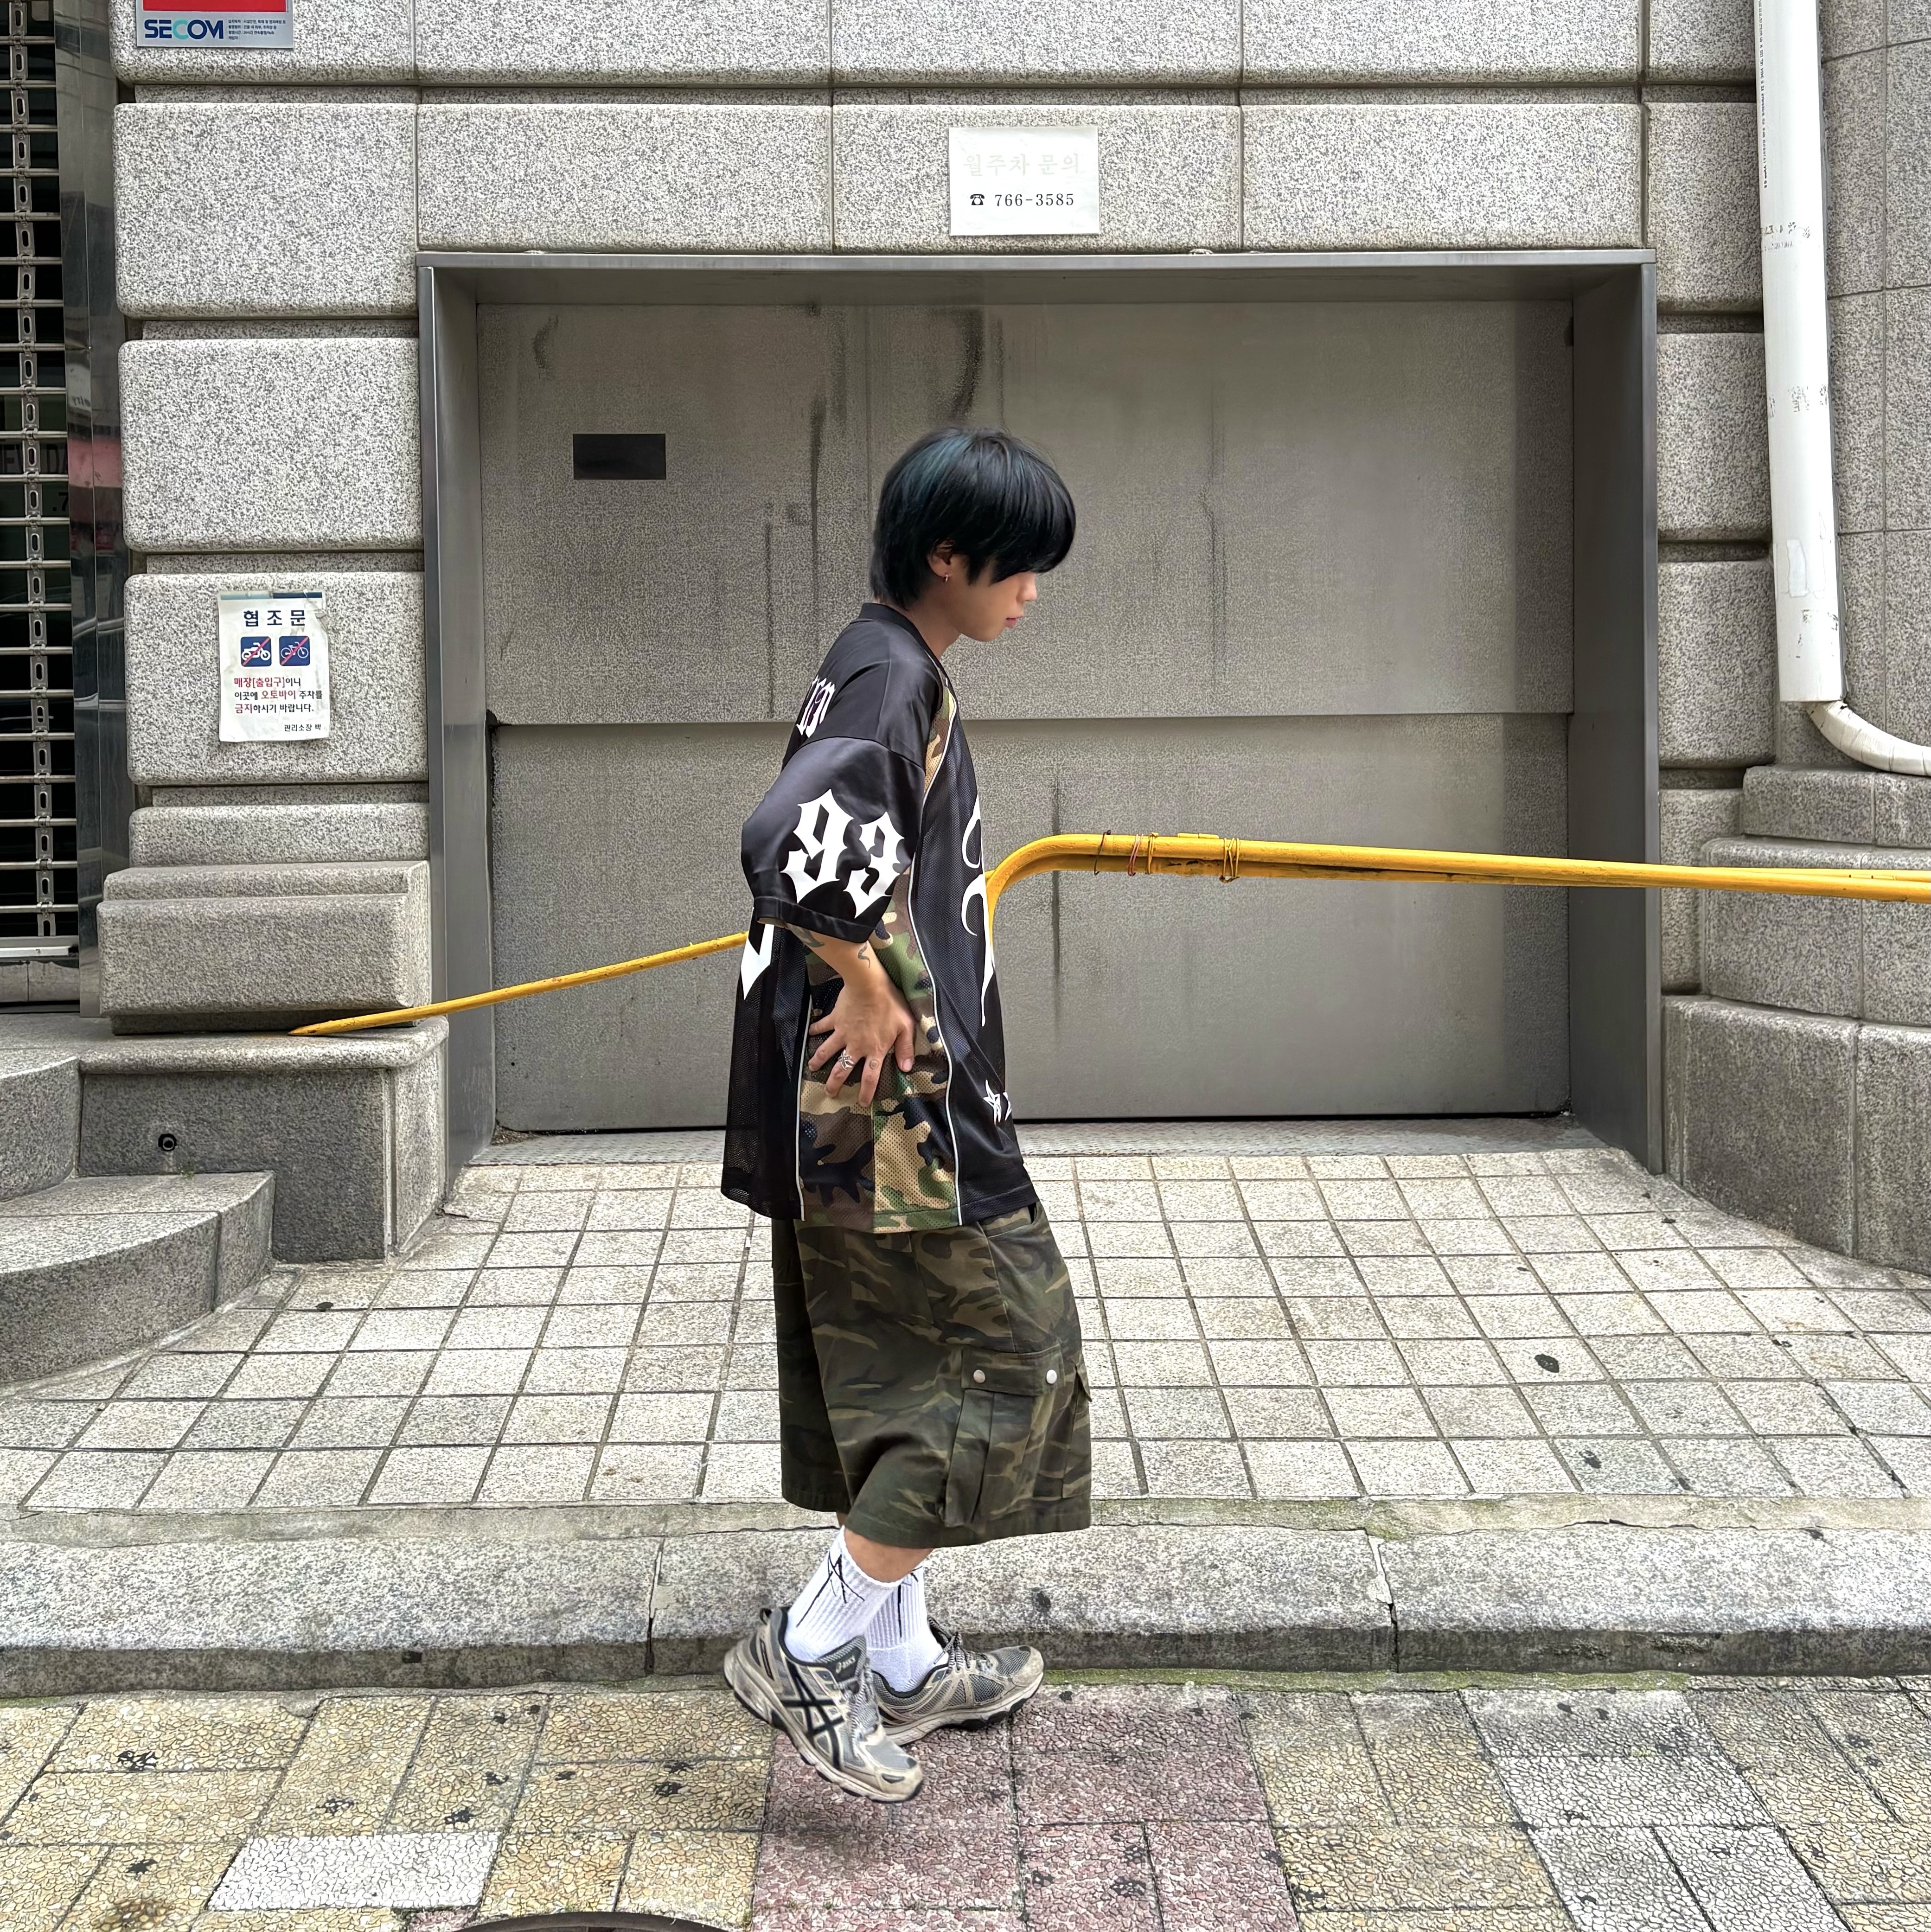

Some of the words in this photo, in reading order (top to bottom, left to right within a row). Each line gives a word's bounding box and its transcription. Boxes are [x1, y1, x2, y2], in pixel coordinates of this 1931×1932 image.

[144, 19, 224, 39] SECOM
[963, 153, 1030, 176] 월주차
[1038, 153, 1079, 175] 문의
[994, 193, 1074, 206] 766-3585
[234, 677, 301, 688] 매장[출입구]이니
[234, 691, 258, 700] 이곳에
[261, 690, 296, 700] 오토바이
[299, 690, 323, 700] 주차를
[235, 703, 276, 714] 금지하시기
[280, 704, 314, 713] 바랍니다.
